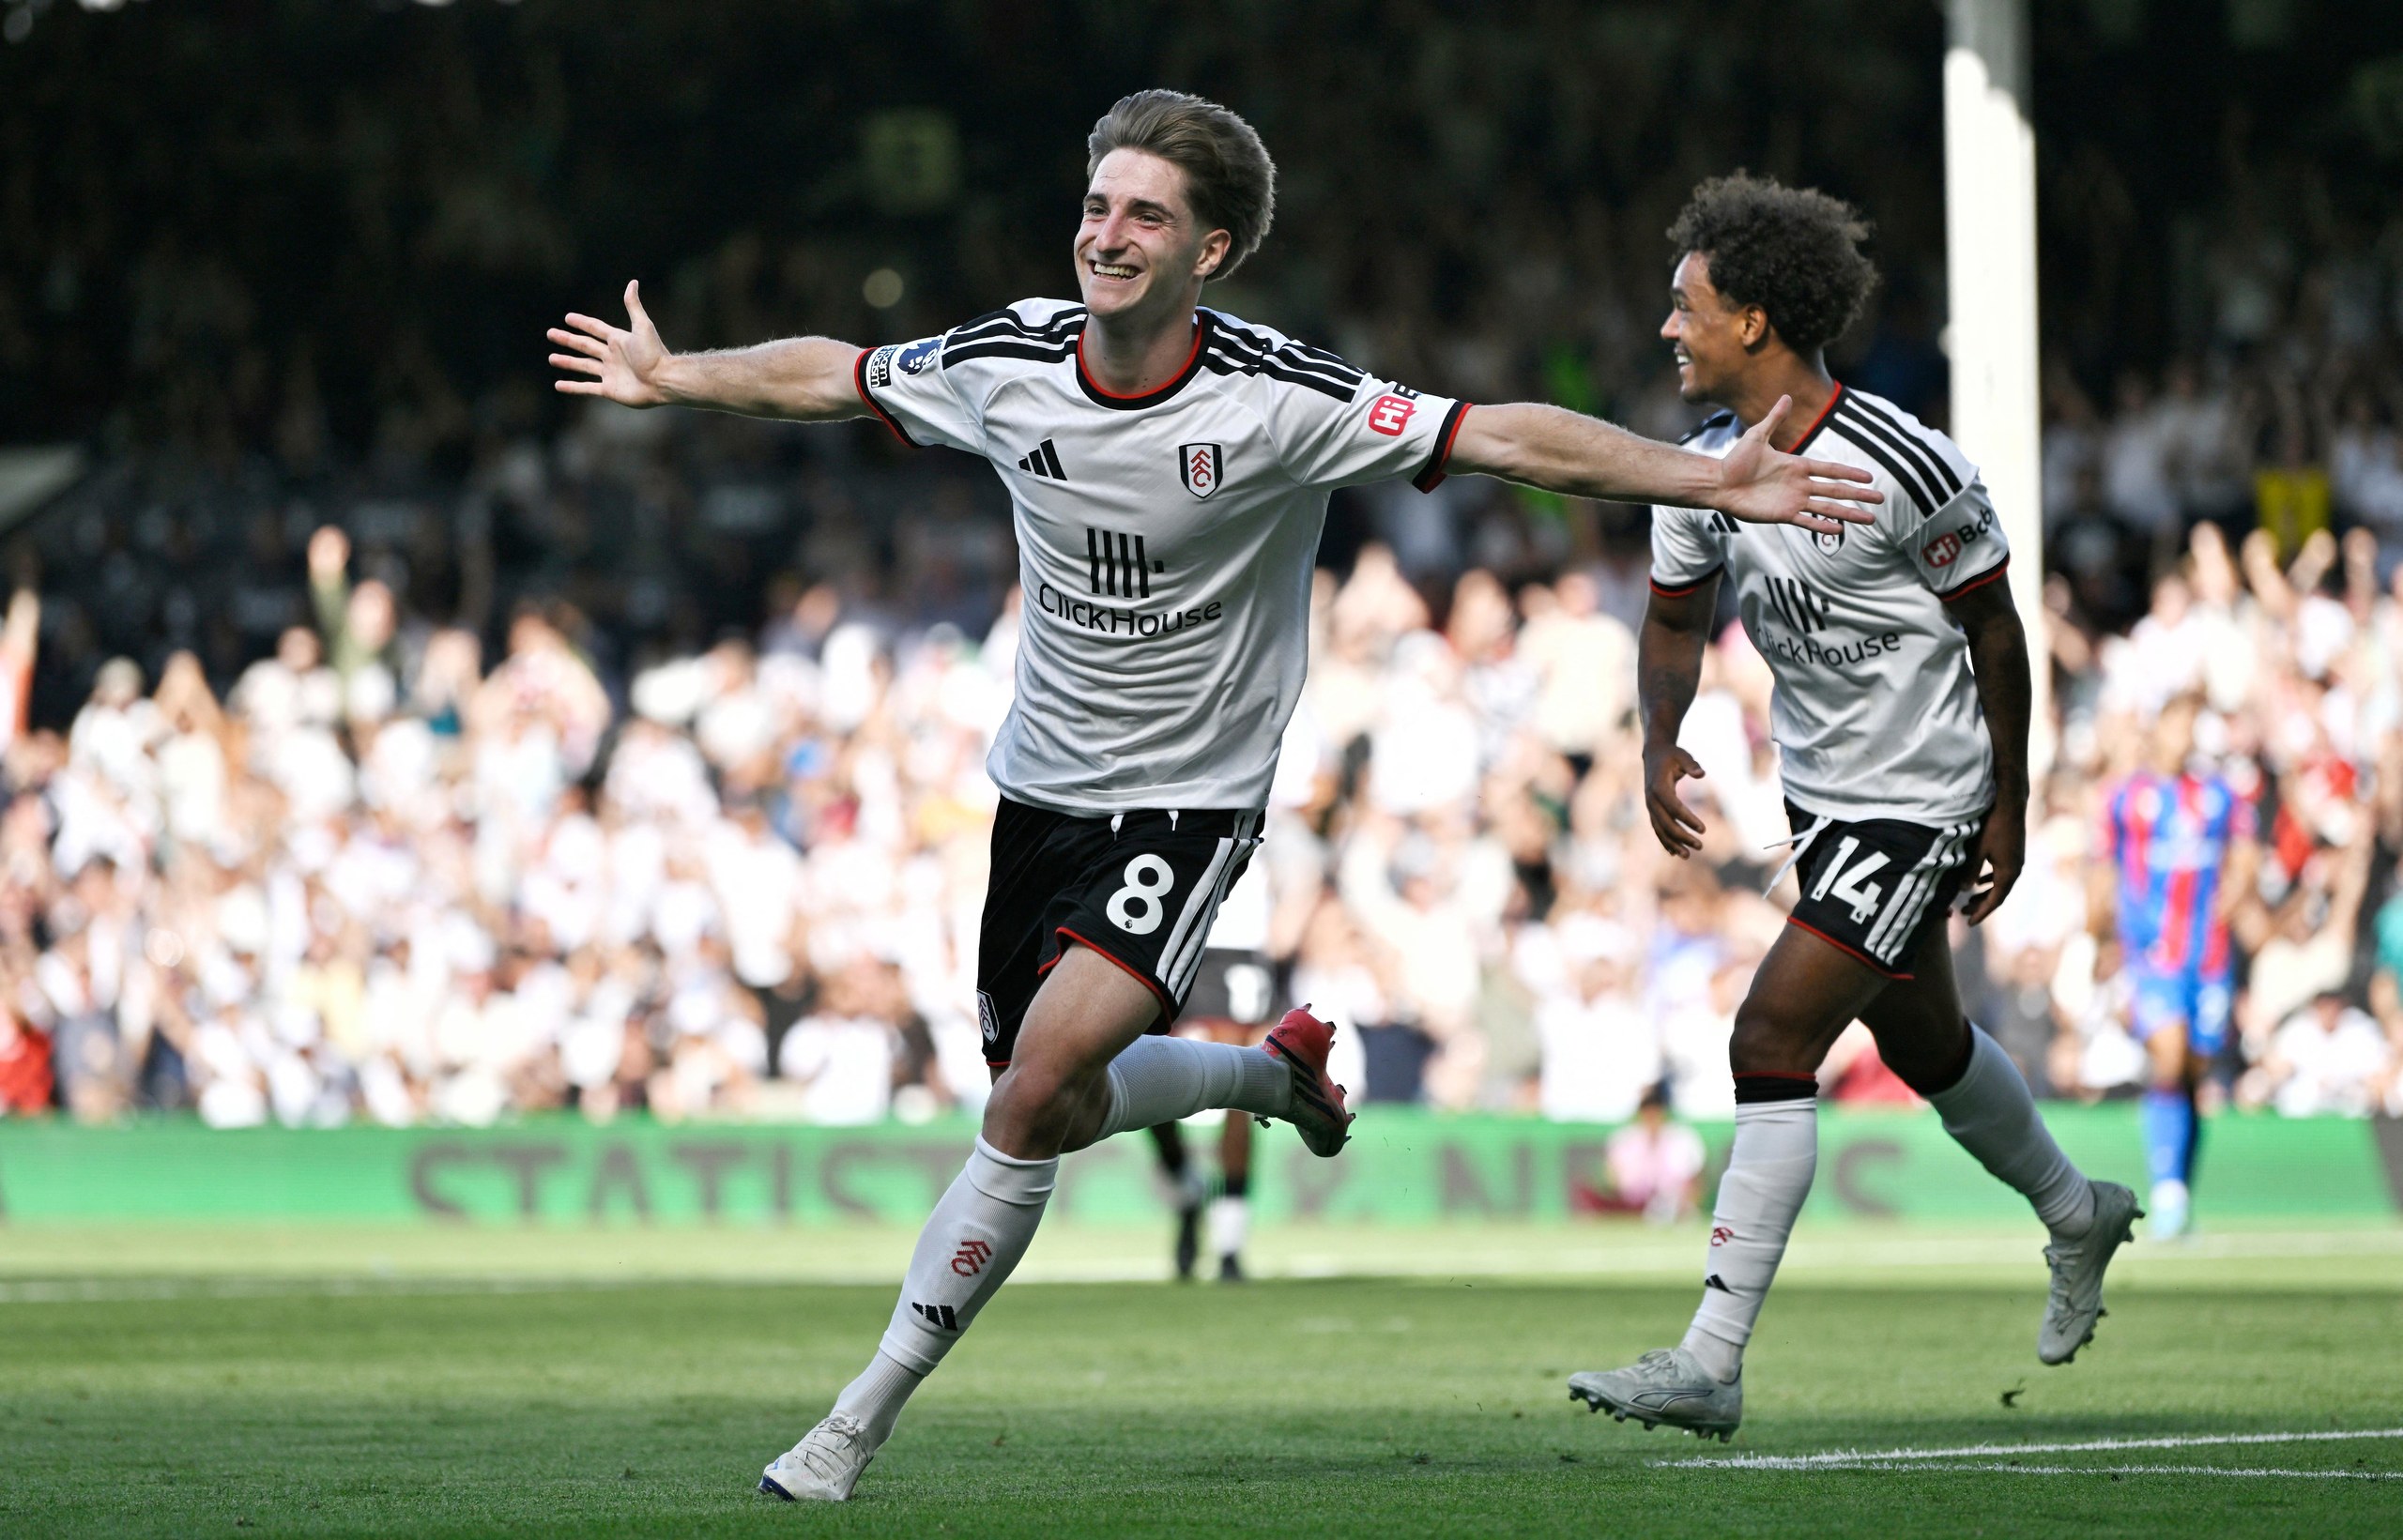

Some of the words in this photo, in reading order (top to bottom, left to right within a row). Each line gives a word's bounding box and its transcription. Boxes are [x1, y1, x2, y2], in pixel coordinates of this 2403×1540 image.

[1038, 582, 1222, 637] ClickHouse
[1106, 853, 1174, 935] 8
[1810, 835, 1891, 925] 14
